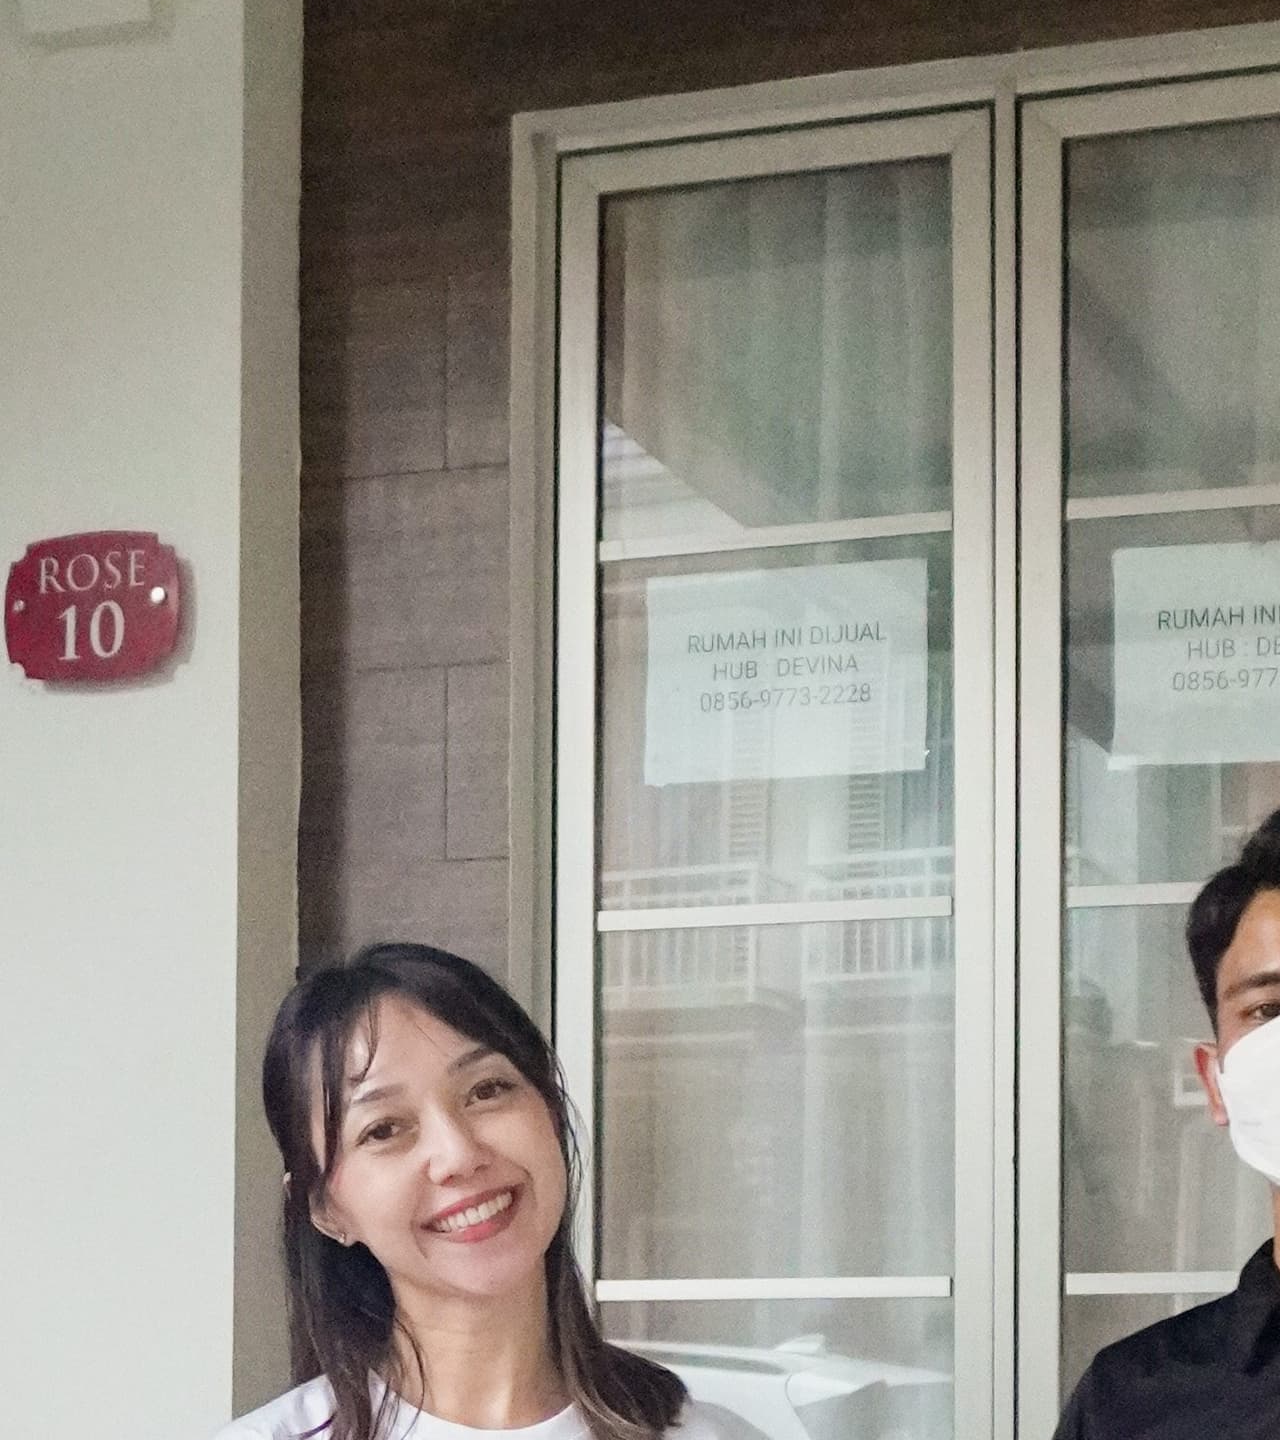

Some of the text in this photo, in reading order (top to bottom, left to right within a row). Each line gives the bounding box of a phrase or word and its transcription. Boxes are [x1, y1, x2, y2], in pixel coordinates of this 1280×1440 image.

[38, 549, 146, 595] ROSE
[56, 599, 126, 662] 10
[1156, 605, 1246, 631] RUMAH
[686, 621, 887, 654] RUMAH INI DIJUAL
[1187, 638, 1237, 661] HUB
[776, 654, 860, 678] DEVINA
[699, 682, 872, 713] 0856-9773-2228
